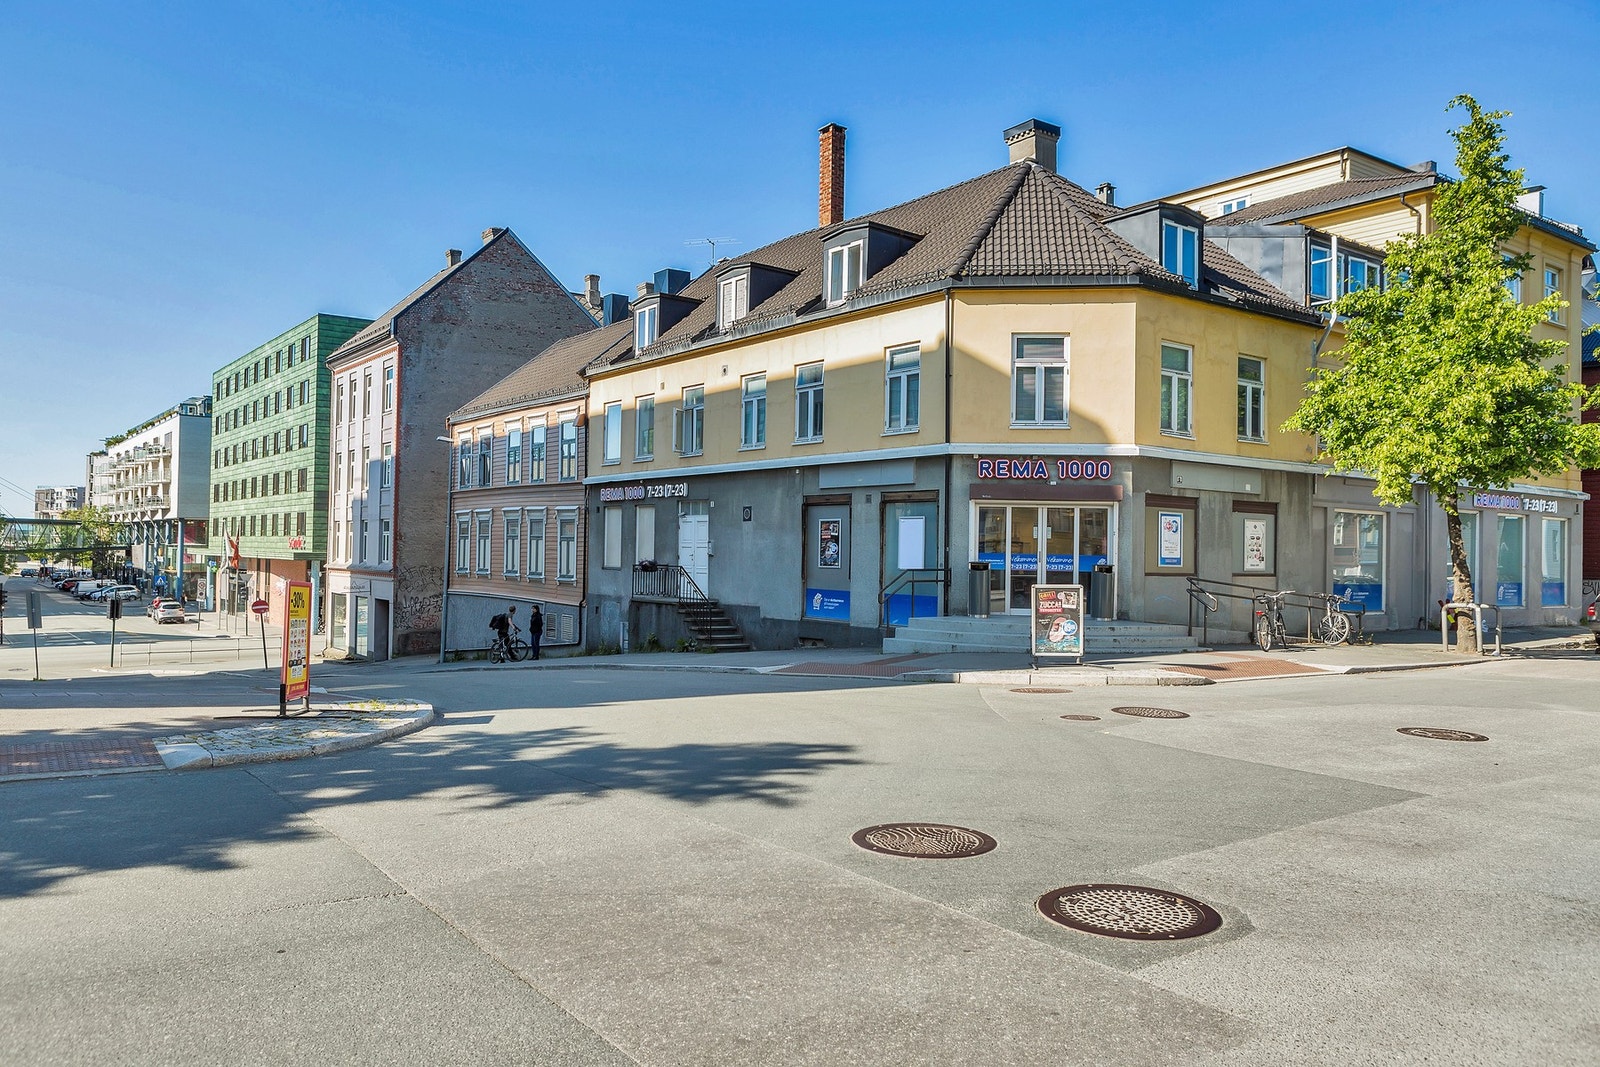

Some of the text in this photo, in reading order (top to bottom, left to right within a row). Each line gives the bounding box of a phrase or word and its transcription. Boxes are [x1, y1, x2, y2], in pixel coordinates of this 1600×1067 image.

[978, 459, 1112, 479] REMA 1000
[600, 487, 624, 501] REMA
[624, 485, 645, 500] 1000
[647, 485, 664, 498] 7-23
[1475, 493, 1499, 508] REMA
[1500, 495, 1520, 510] 1000
[291, 591, 305, 609] -30%
